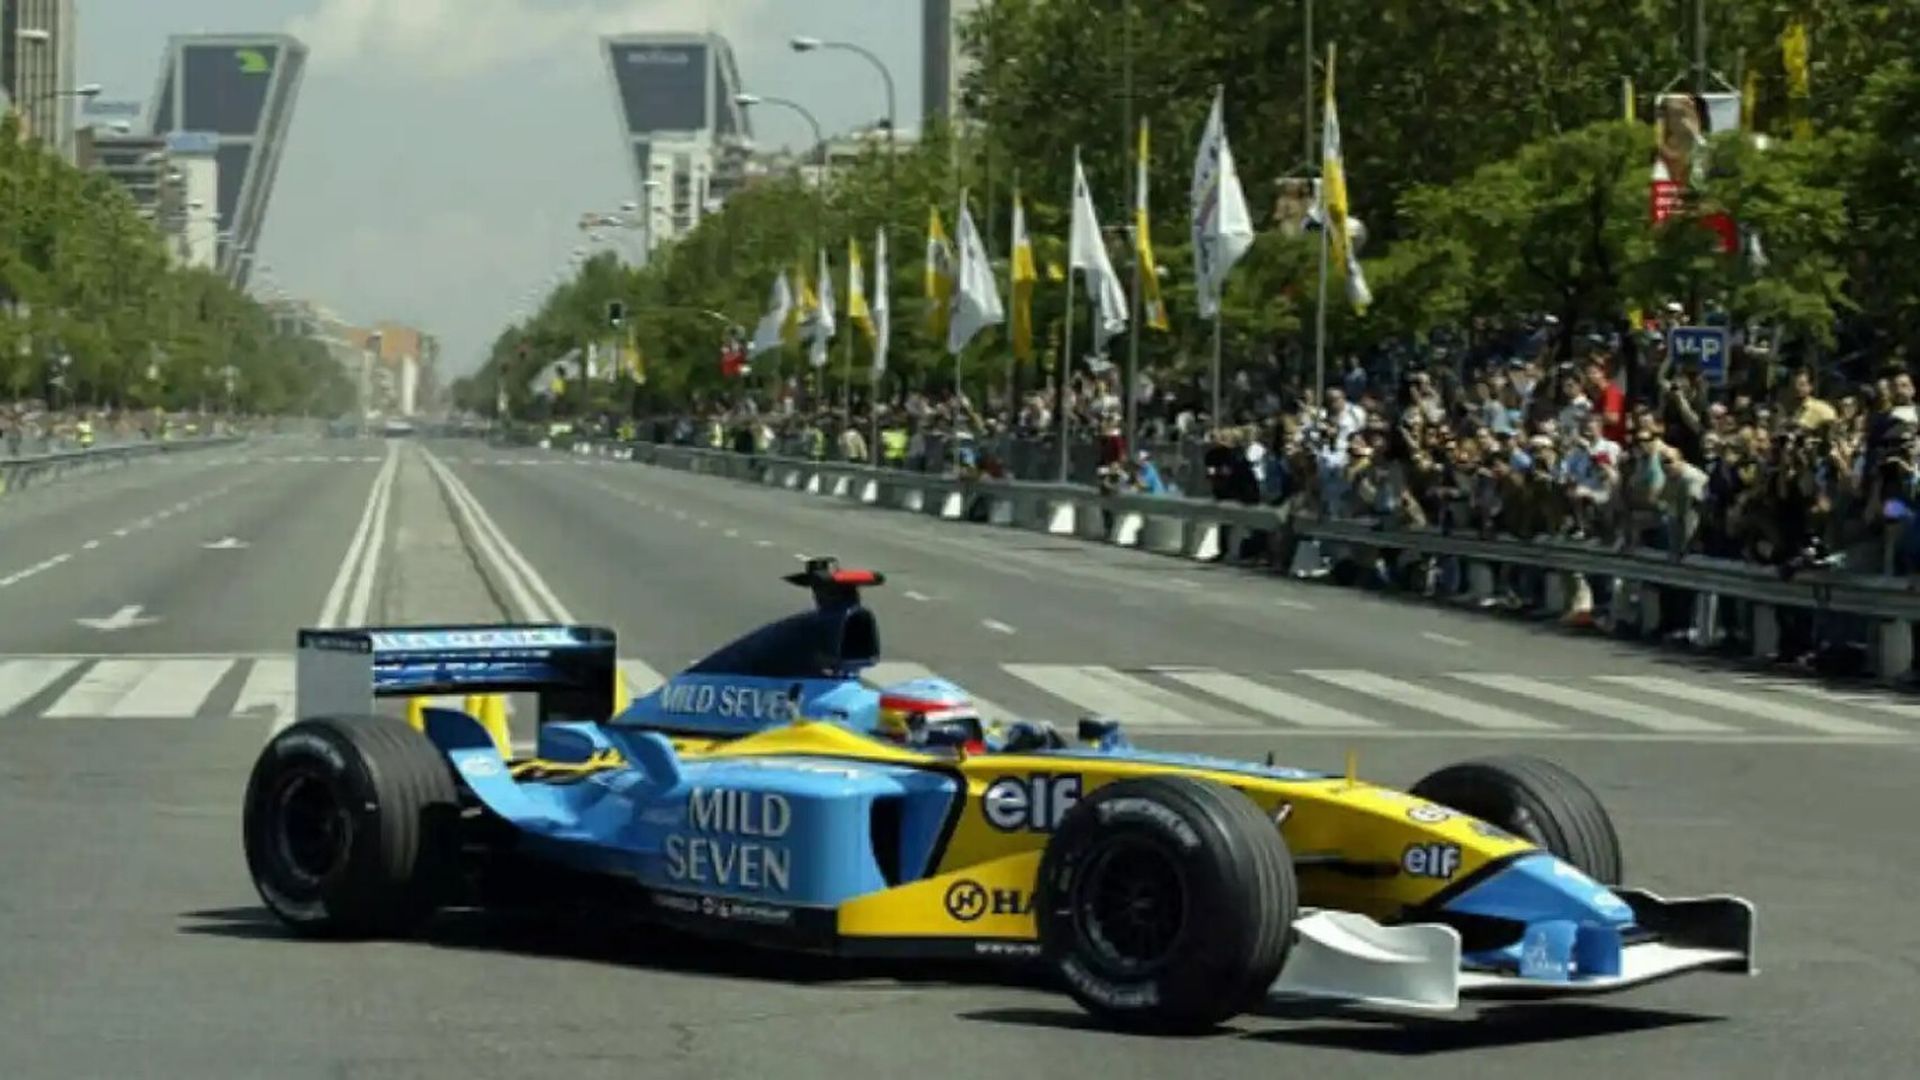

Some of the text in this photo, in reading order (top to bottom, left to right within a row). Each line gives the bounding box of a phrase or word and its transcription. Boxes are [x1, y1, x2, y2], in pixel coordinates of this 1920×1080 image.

[660, 684, 715, 714] MILD
[689, 787, 791, 838] MILD
[983, 773, 1081, 833] elf
[666, 834, 790, 891] SEVEN
[1404, 844, 1459, 878] elf
